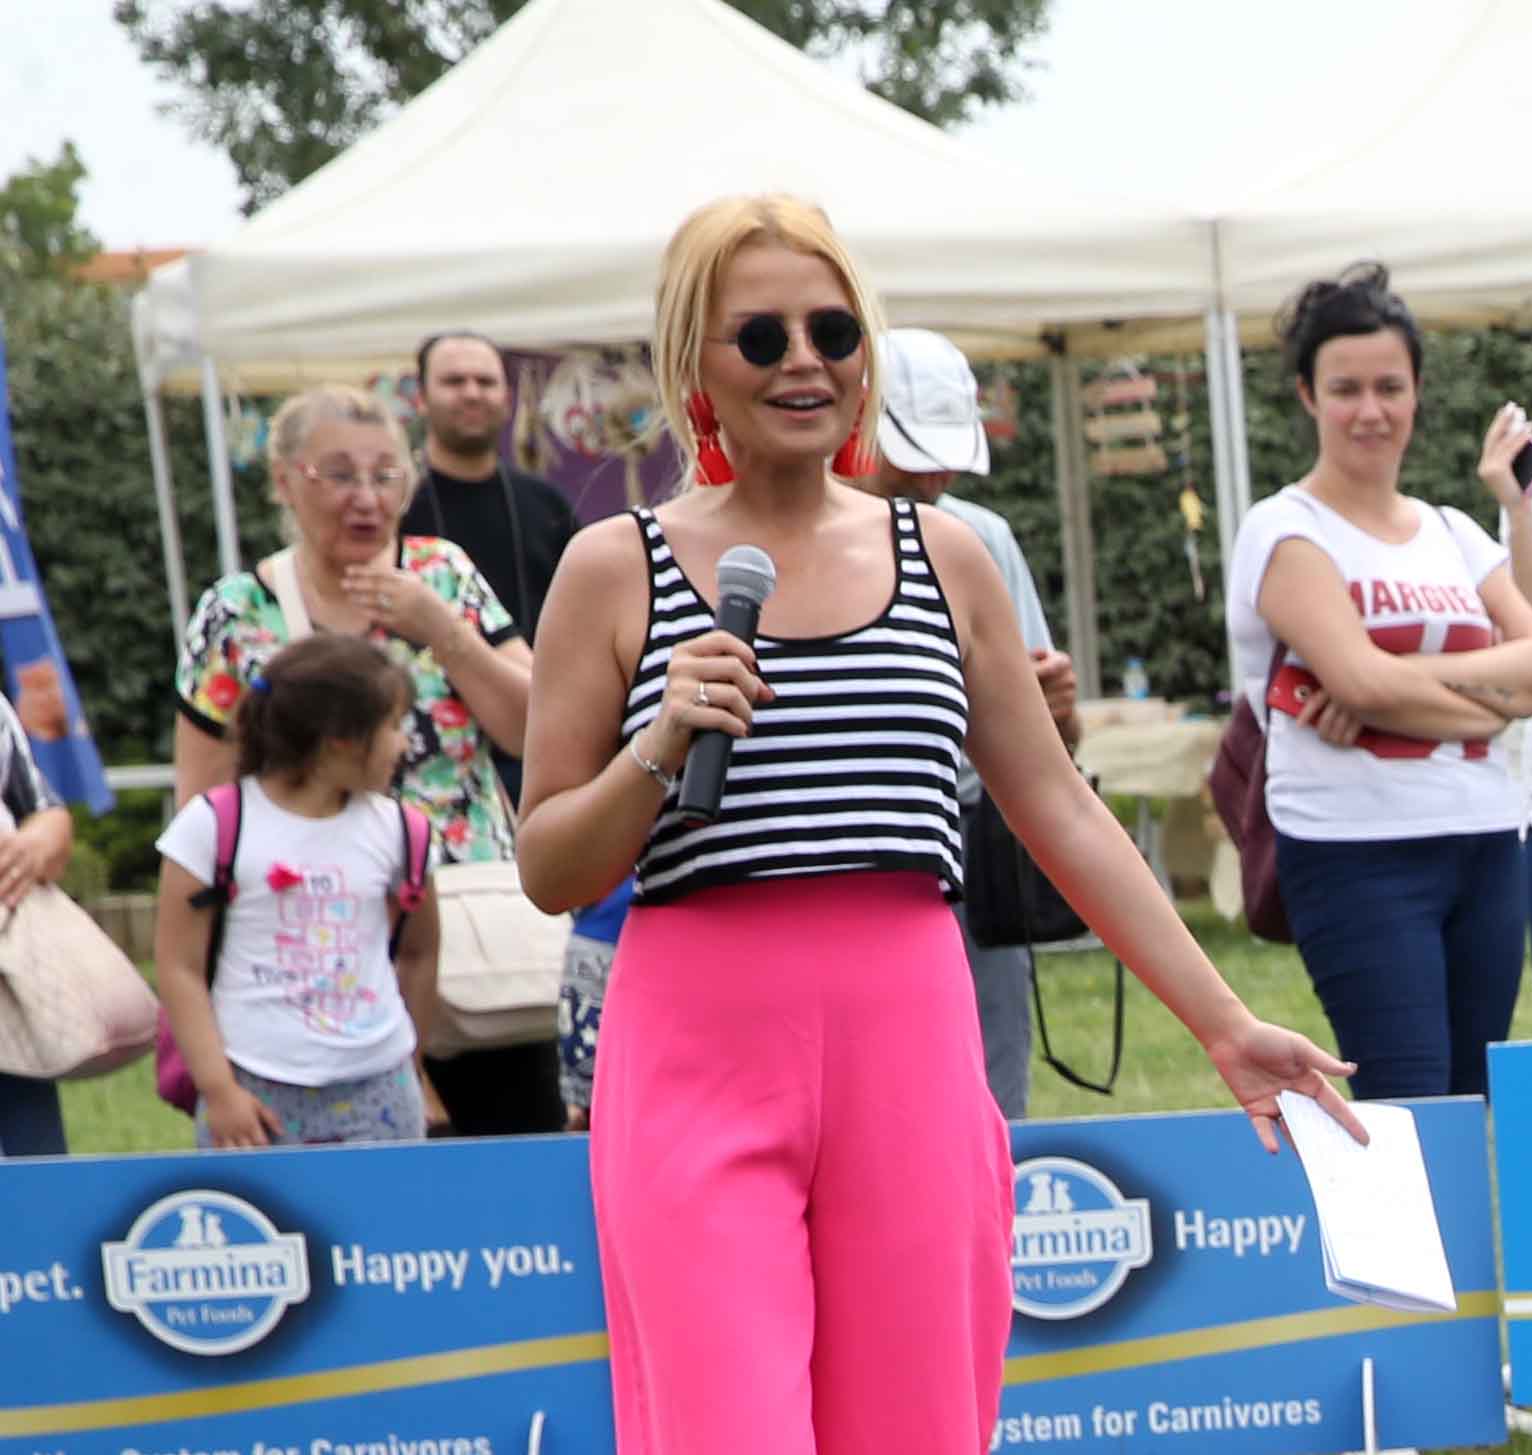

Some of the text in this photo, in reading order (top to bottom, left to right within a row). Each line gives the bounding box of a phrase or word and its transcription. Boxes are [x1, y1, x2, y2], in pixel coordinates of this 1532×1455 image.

[1013, 1219, 1129, 1256] rmina
[1174, 1209, 1305, 1256] Happy
[0, 1262, 84, 1312] pet.
[126, 1253, 287, 1294] Farmina
[331, 1244, 574, 1293] Happy you.
[166, 1304, 254, 1326] Pet Foods
[991, 1396, 1322, 1452] ystem for Carnivores
